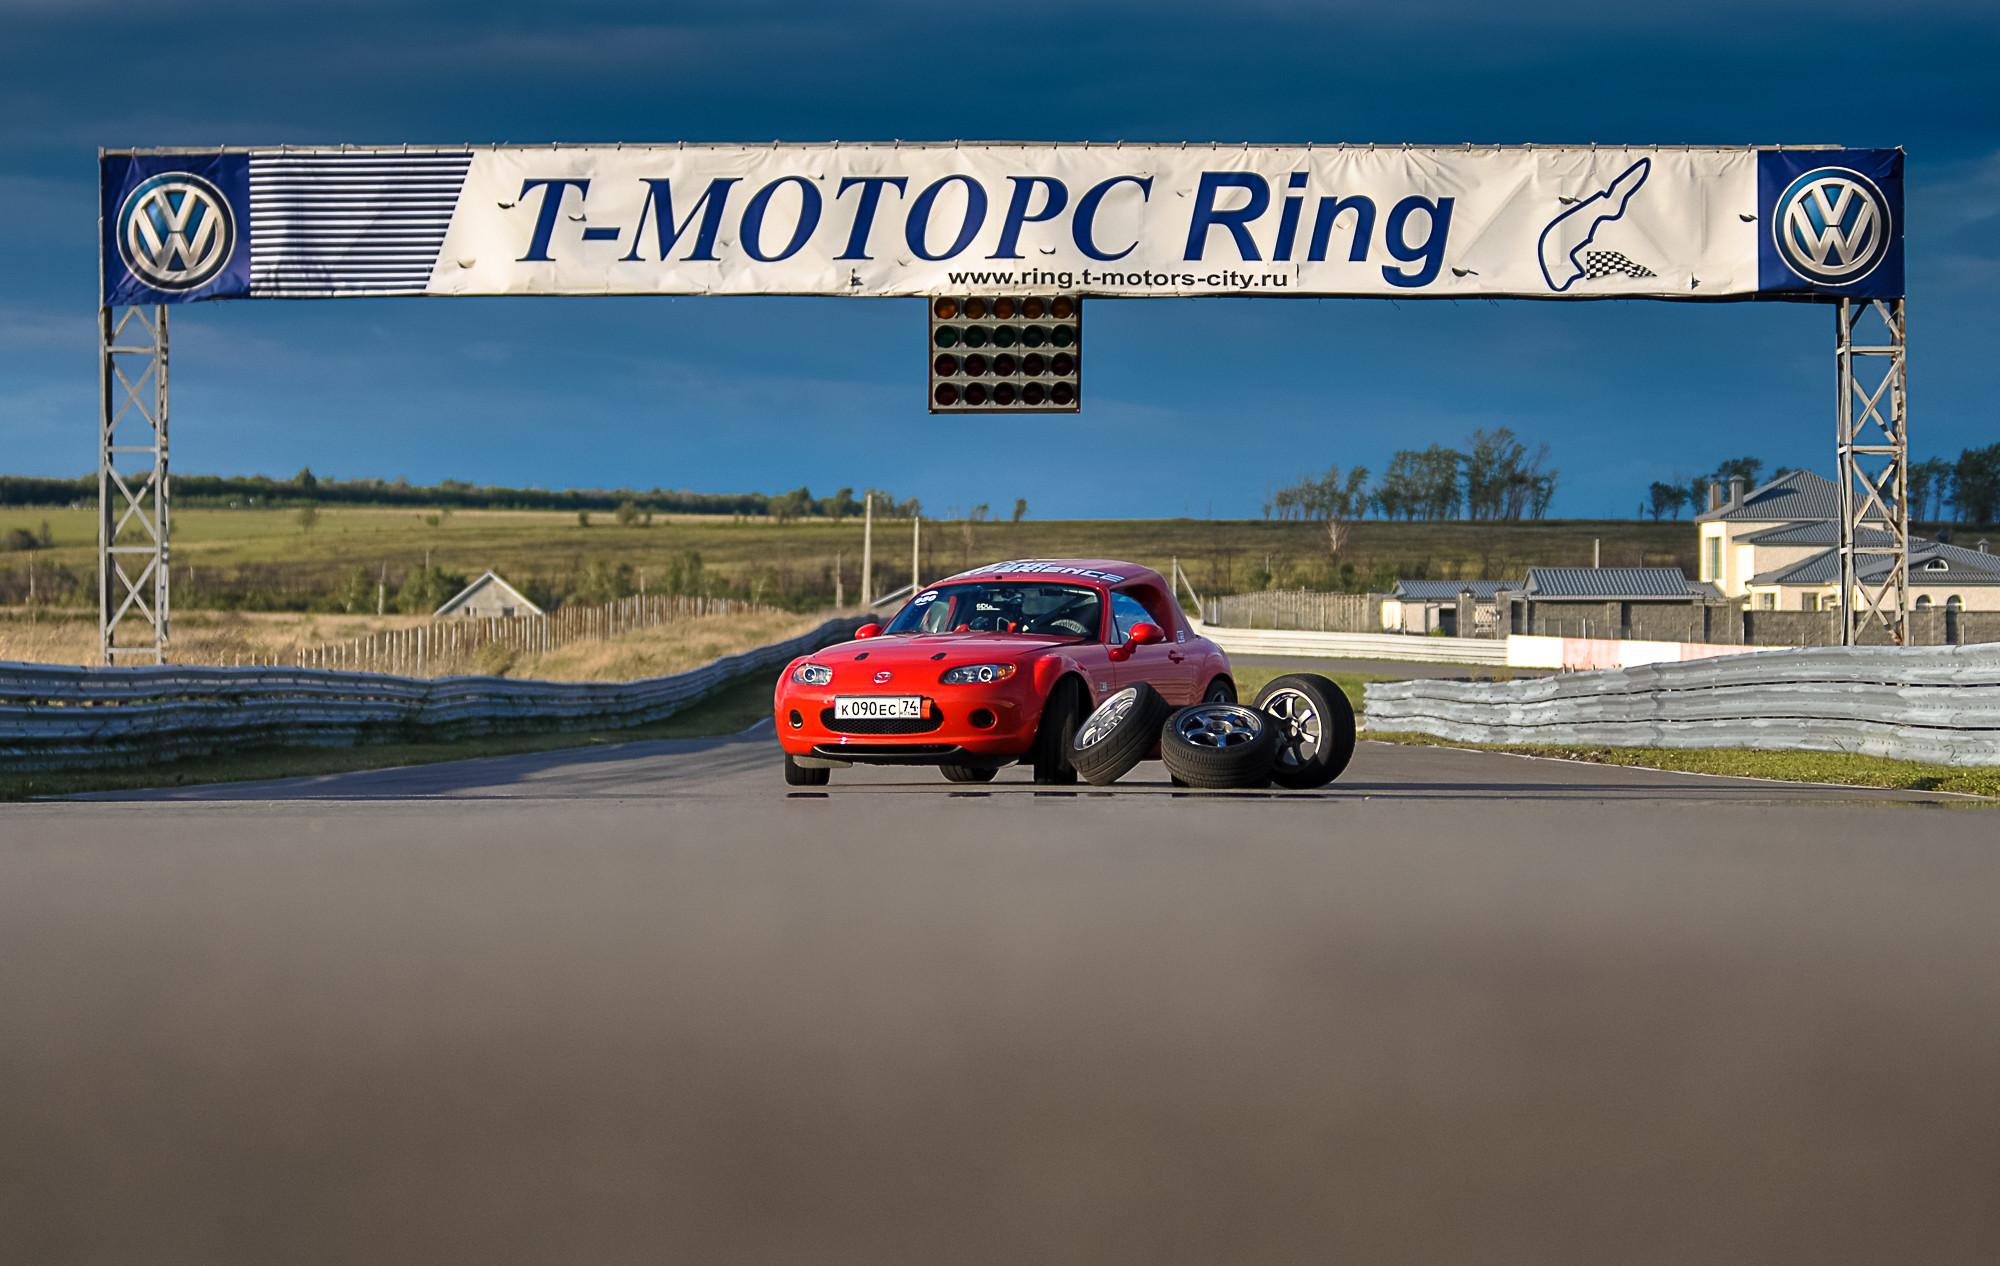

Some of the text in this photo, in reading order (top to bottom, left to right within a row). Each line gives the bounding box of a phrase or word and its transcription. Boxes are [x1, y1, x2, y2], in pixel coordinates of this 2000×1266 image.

[1183, 172, 1453, 289] Ring
[948, 268, 1289, 290] www.ring.t-motors-city.ru
[902, 700, 917, 712] 74
